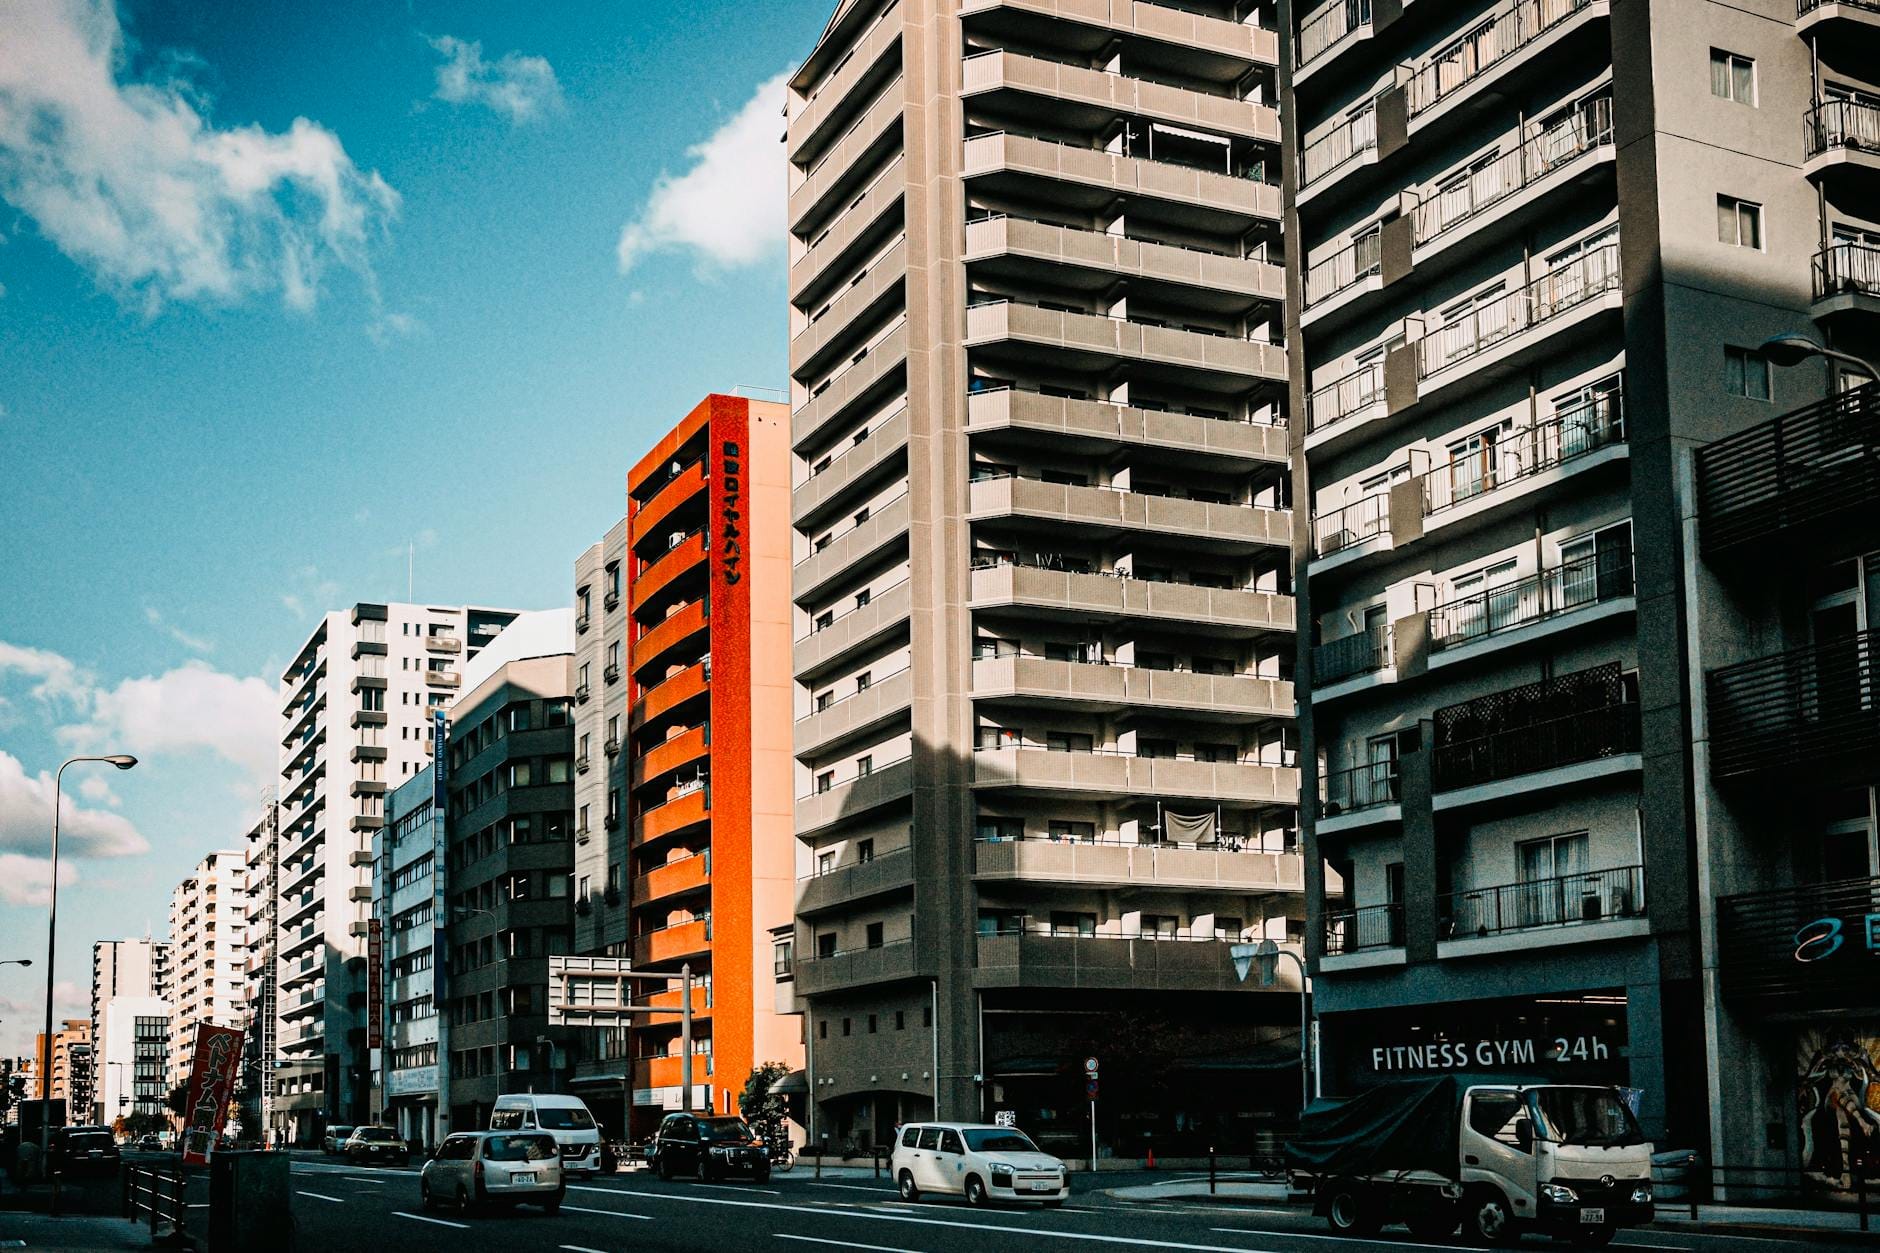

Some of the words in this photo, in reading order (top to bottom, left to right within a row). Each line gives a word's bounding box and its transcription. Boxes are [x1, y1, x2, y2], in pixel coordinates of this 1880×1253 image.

[1372, 1042, 1468, 1070] FITNESS
[1475, 1039, 1535, 1066] GYM
[1554, 1036, 1609, 1062] 24h
